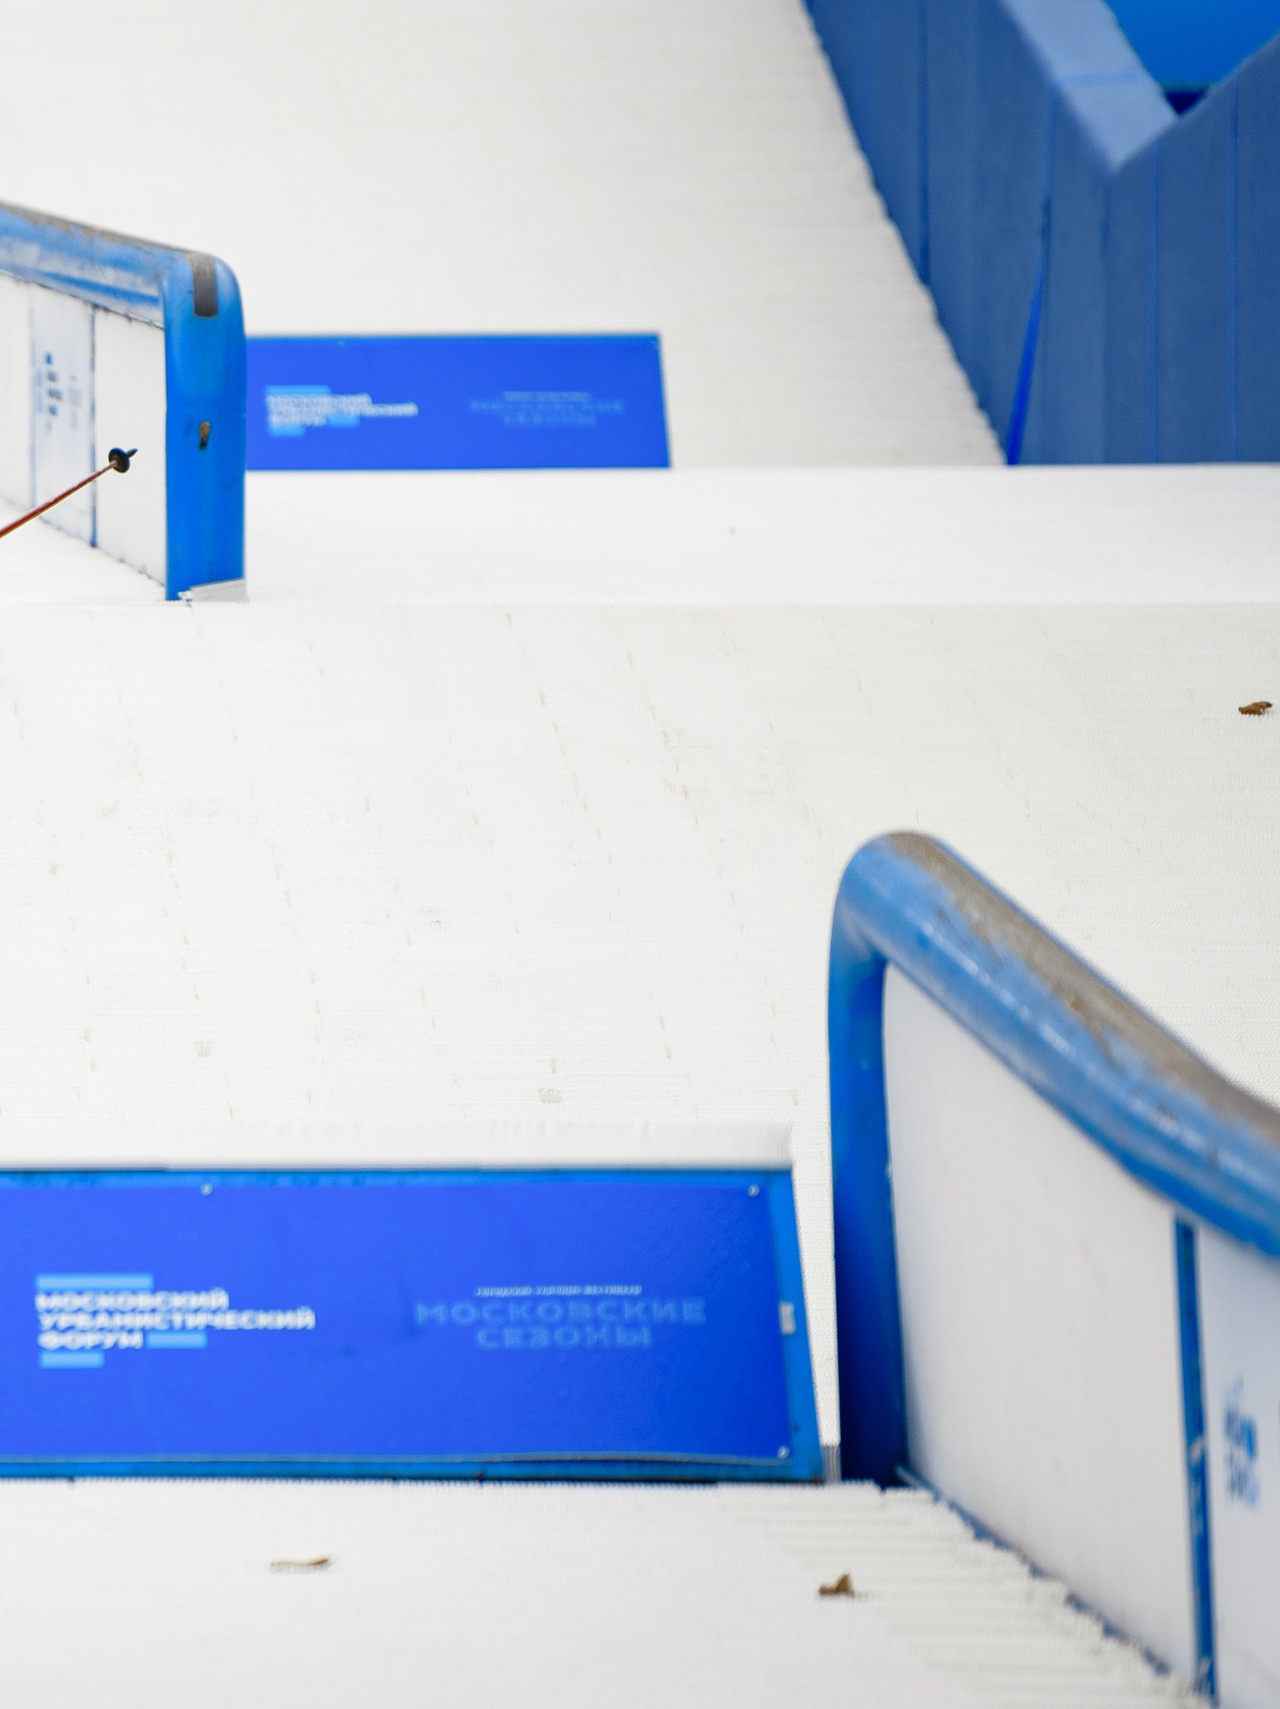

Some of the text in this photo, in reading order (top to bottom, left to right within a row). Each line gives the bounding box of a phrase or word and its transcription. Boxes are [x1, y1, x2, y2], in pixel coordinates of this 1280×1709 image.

[35, 1286, 229, 1312] МОСКОВСКИЙ
[415, 1298, 707, 1326] МОСКОВСКИЕ
[38, 1329, 144, 1350] ФОРУМ
[475, 1325, 652, 1350] СЕЗОНЫ
